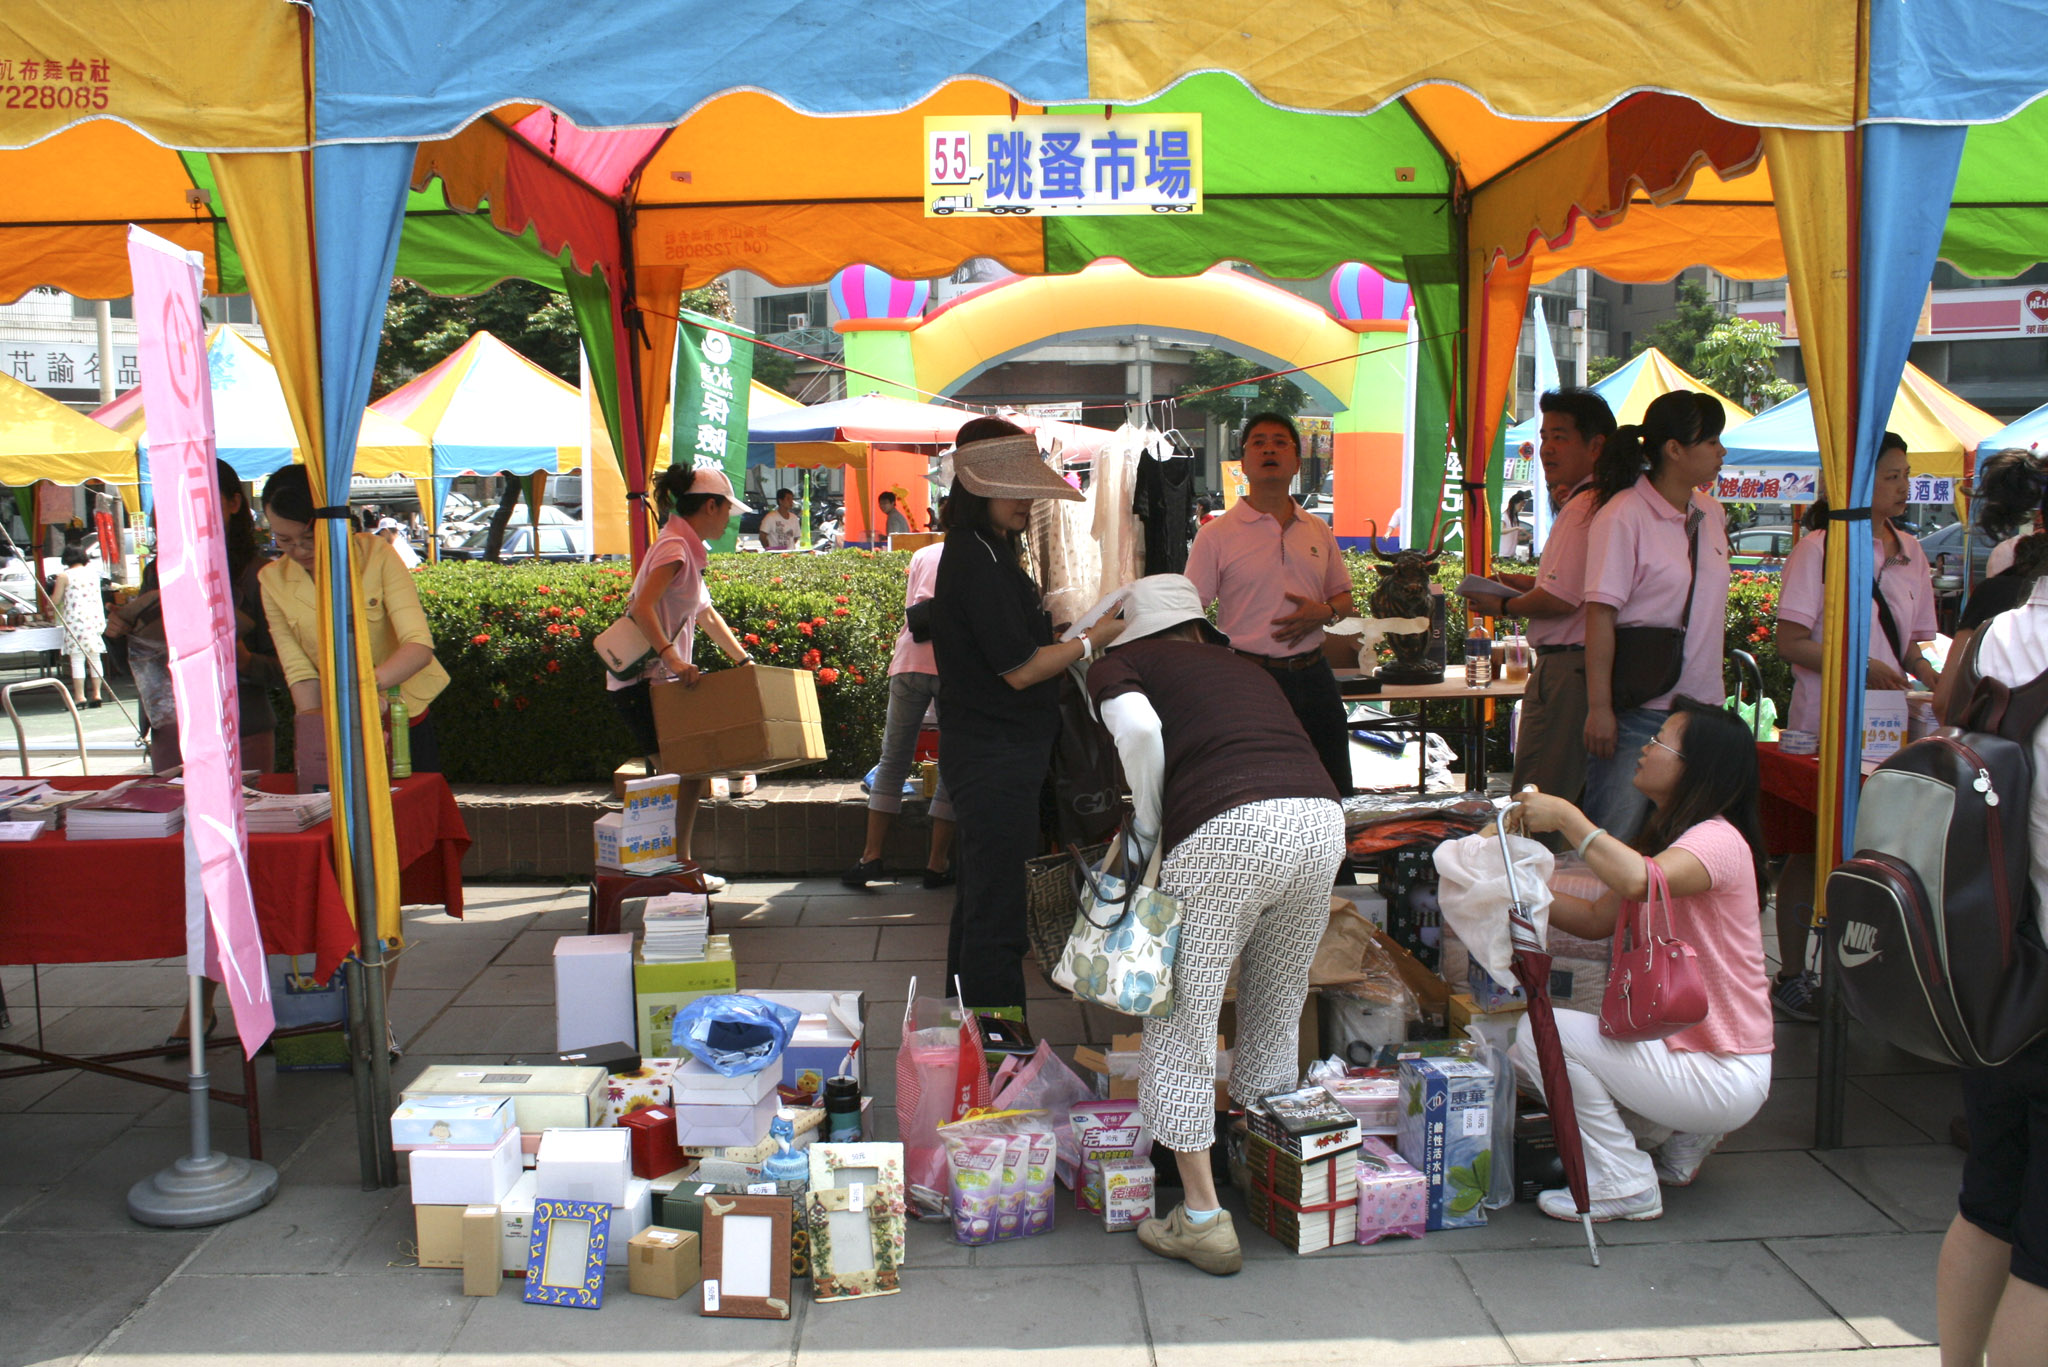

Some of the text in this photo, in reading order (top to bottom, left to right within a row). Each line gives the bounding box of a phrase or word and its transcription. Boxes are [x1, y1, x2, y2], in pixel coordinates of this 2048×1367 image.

[935, 138, 967, 180] 55
[986, 130, 1192, 201] 跳蚤市場
[1718, 477, 1780, 499] 烤魷魚
[1907, 480, 1949, 502] 酒螺
[1843, 920, 1878, 953] NIKE
